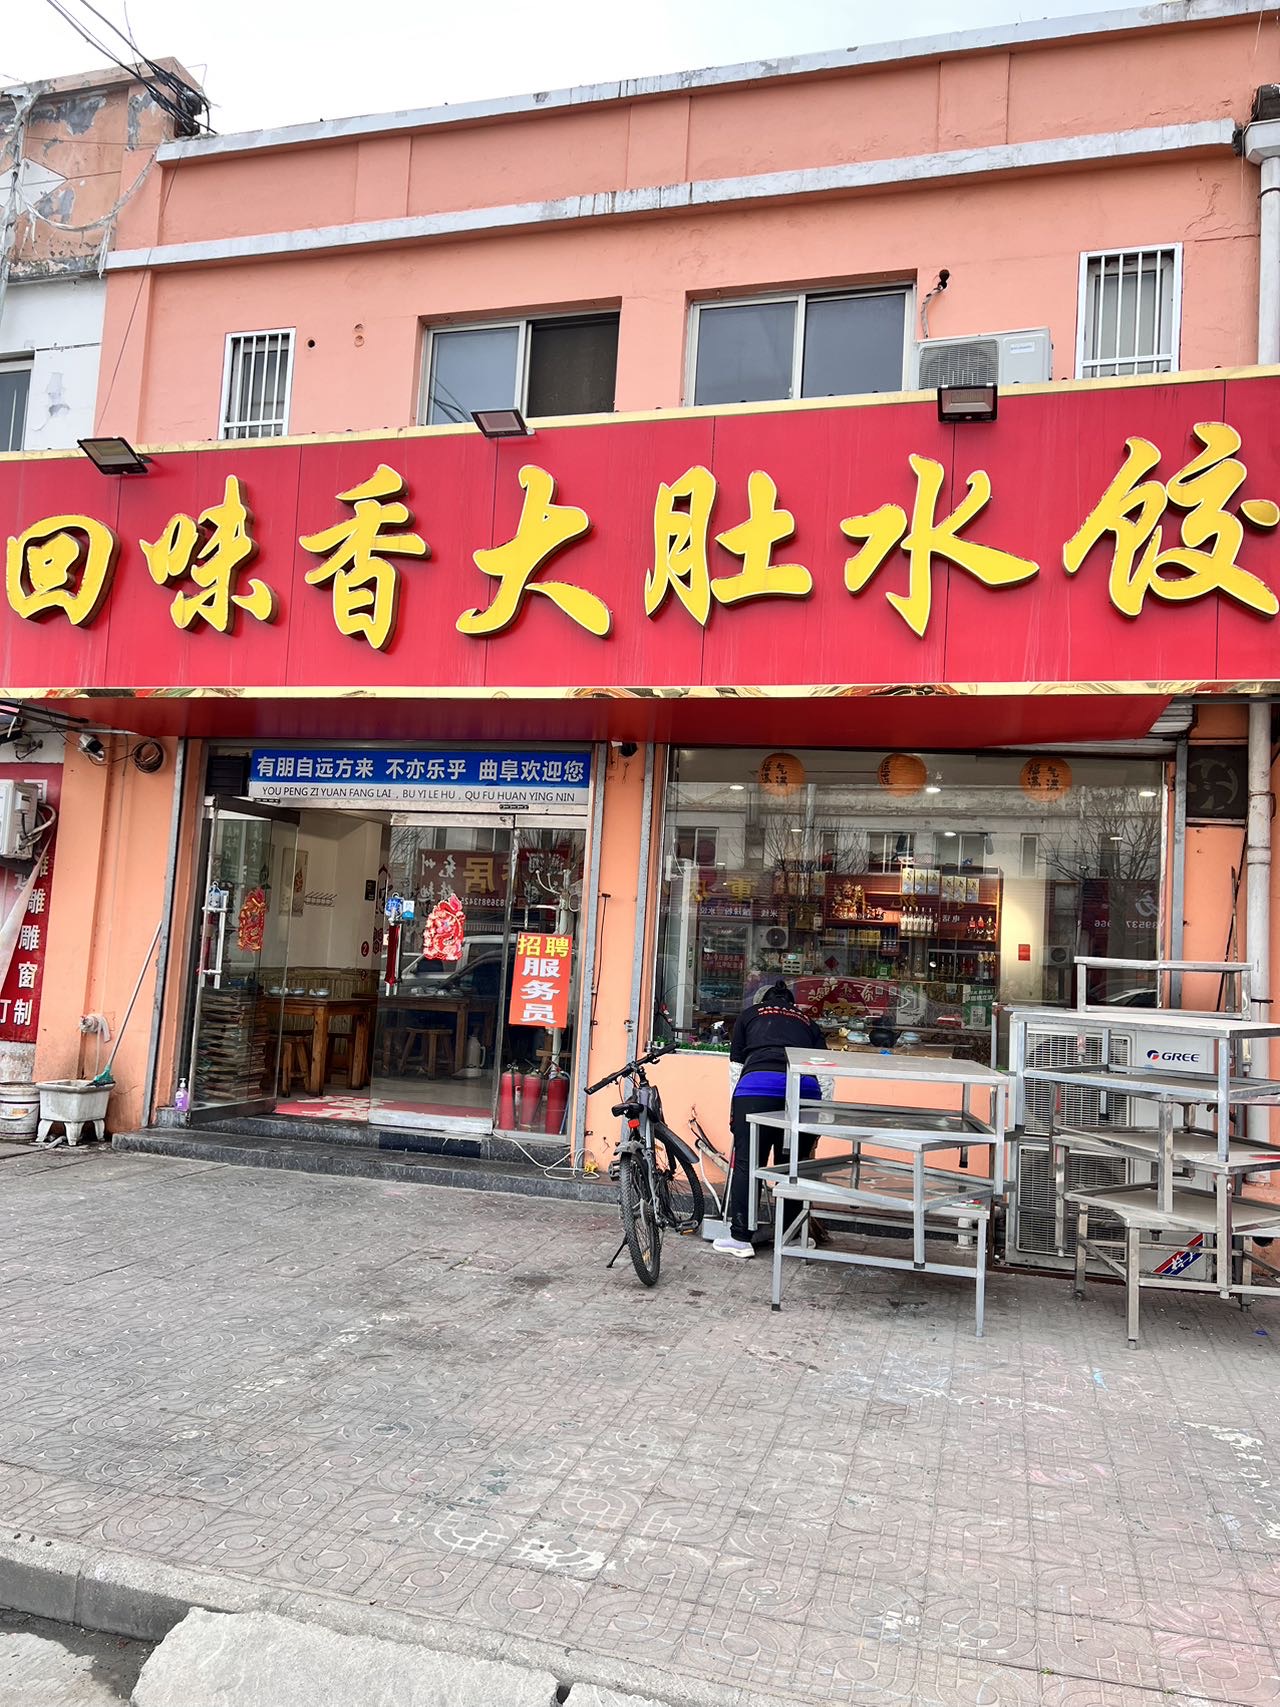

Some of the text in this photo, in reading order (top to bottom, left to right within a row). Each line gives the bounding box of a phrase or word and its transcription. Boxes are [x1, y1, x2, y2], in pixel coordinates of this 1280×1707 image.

[6, 421, 1280, 650] 回味香大肚水饺
[257, 756, 584, 783] 有朋自远方来 不亦乐乎 曲阜欢迎您
[262, 786, 282, 796] YOU
[283, 787, 308, 797] PENG
[310, 787, 319, 797] ZI
[321, 787, 347, 798] YUAN
[349, 788, 374, 798] FANG
[402, 789, 415, 798] BU
[417, 789, 427, 799] YI
[428, 790, 439, 799] LE
[464, 790, 480, 801] QU
[482, 791, 495, 800] FU
[497, 791, 527, 801] HUAN
[529, 792, 554, 801] YING
[556, 792, 575, 802] NIN
[517, 935, 570, 958] 招聘
[519, 956, 561, 1025] 服务员
[1161, 1051, 1200, 1063] GREE
